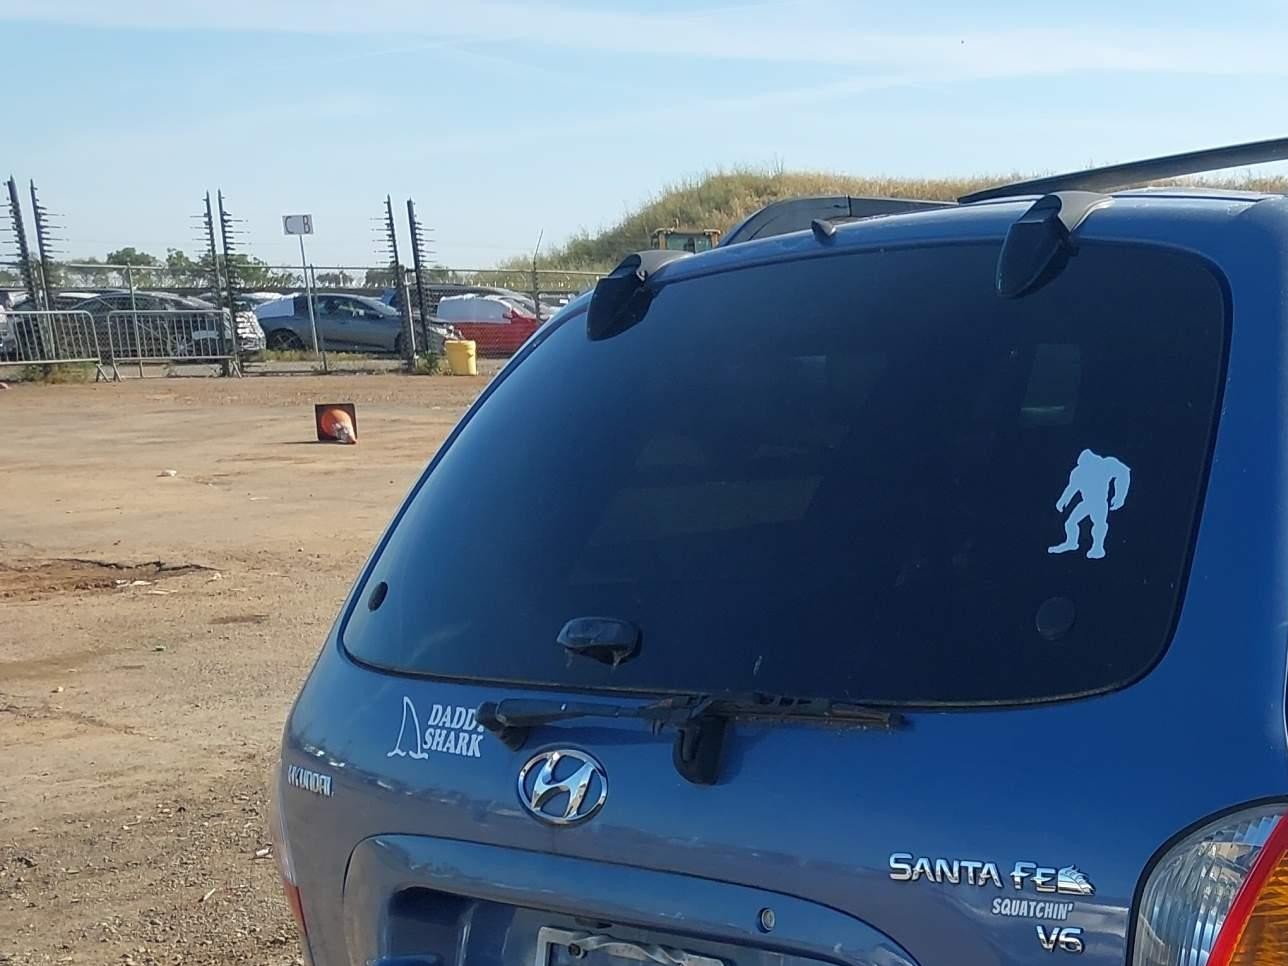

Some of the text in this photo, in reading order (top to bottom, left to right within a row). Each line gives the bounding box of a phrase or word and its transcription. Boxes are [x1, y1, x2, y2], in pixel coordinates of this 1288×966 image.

[423, 728, 483, 757] SHARK
[889, 852, 1057, 894] SANTA FE
[992, 898, 1073, 920] SQUATCHIN'
[1036, 924, 1086, 953] V6
